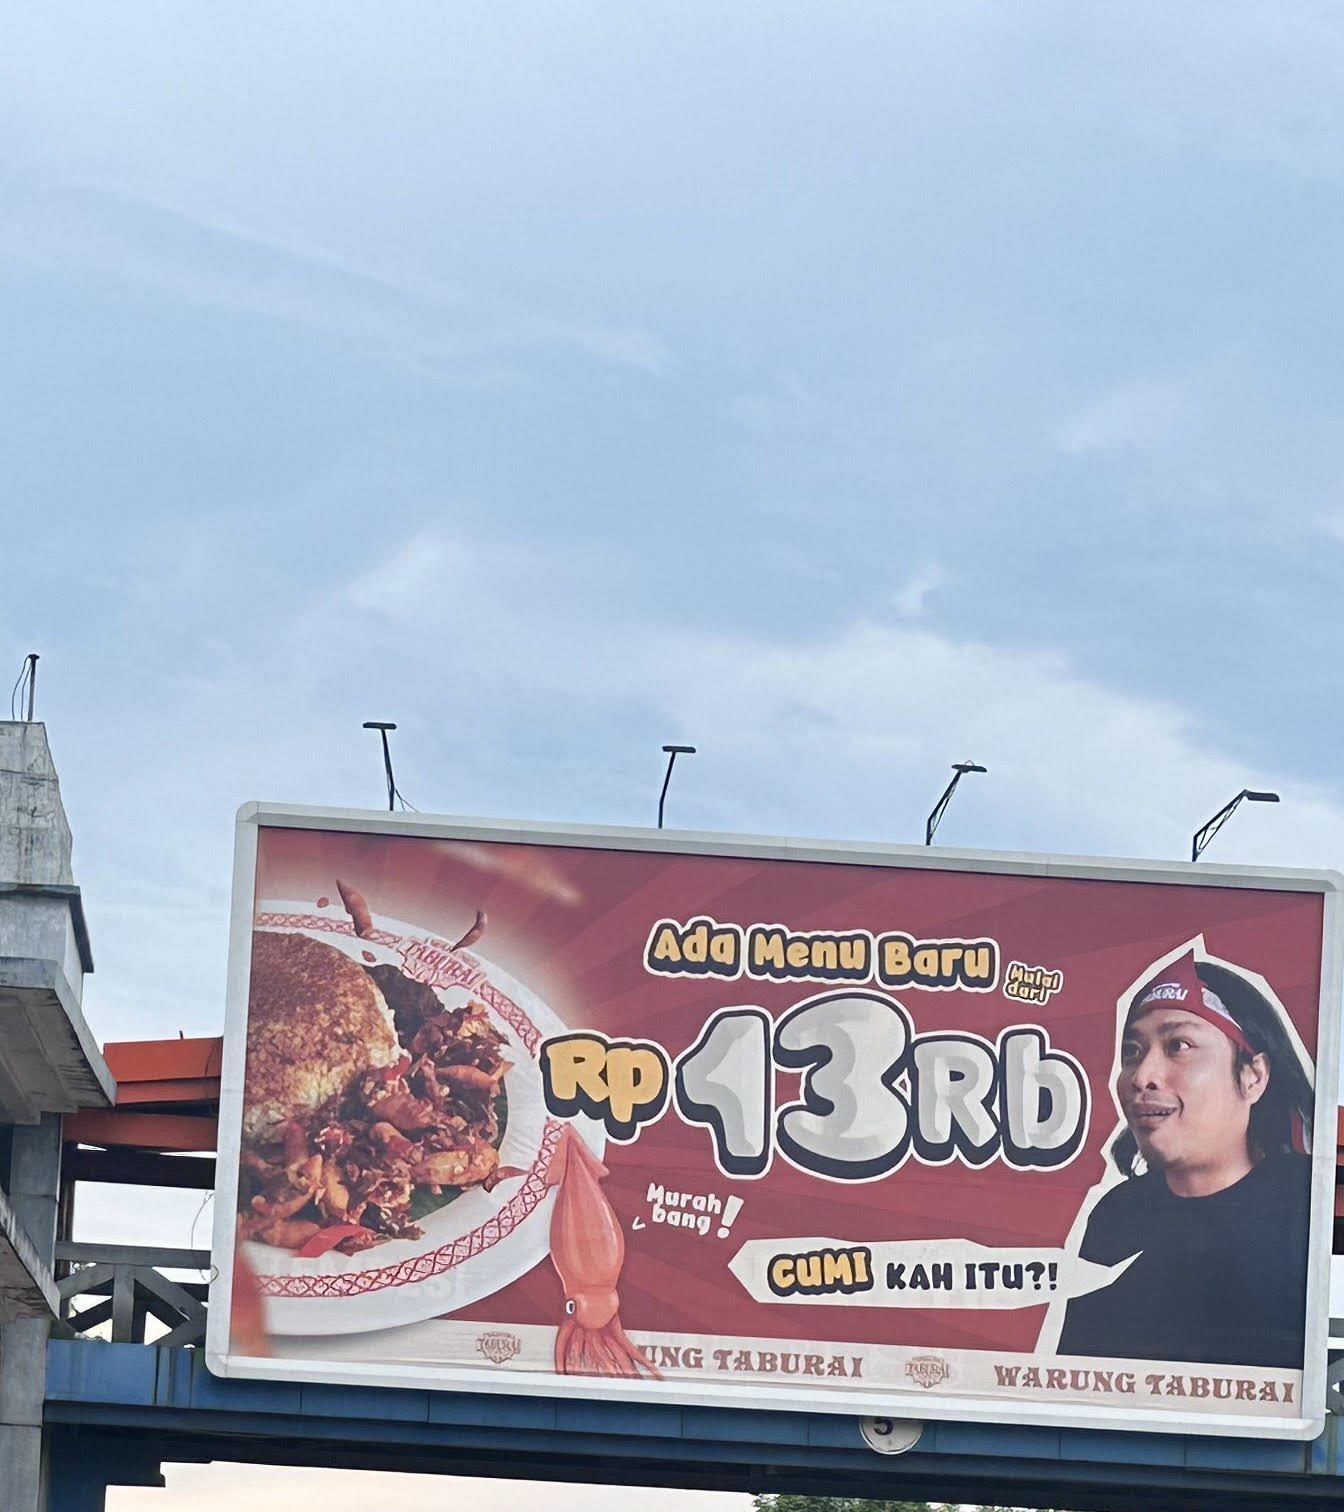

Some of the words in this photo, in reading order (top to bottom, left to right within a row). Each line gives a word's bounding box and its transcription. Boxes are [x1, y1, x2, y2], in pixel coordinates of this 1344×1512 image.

[653, 923, 737, 968] Ada
[753, 930, 868, 972] Menu
[882, 939, 992, 980] Baru
[1007, 982, 1045, 1001] dari
[1010, 964, 1059, 989] Mulai
[543, 1037, 663, 1126] Rp
[646, 1183, 722, 1214] Murah
[769, 1250, 871, 1291] CUMI
[886, 1262, 953, 1290] KAH
[965, 1261, 1058, 1290] ITU?!
[637, 1345, 704, 1369] UNG
[712, 1350, 863, 1378] TABURAI
[993, 1365, 1136, 1394] WARUNG
[1145, 1374, 1295, 1403] TABURAI
